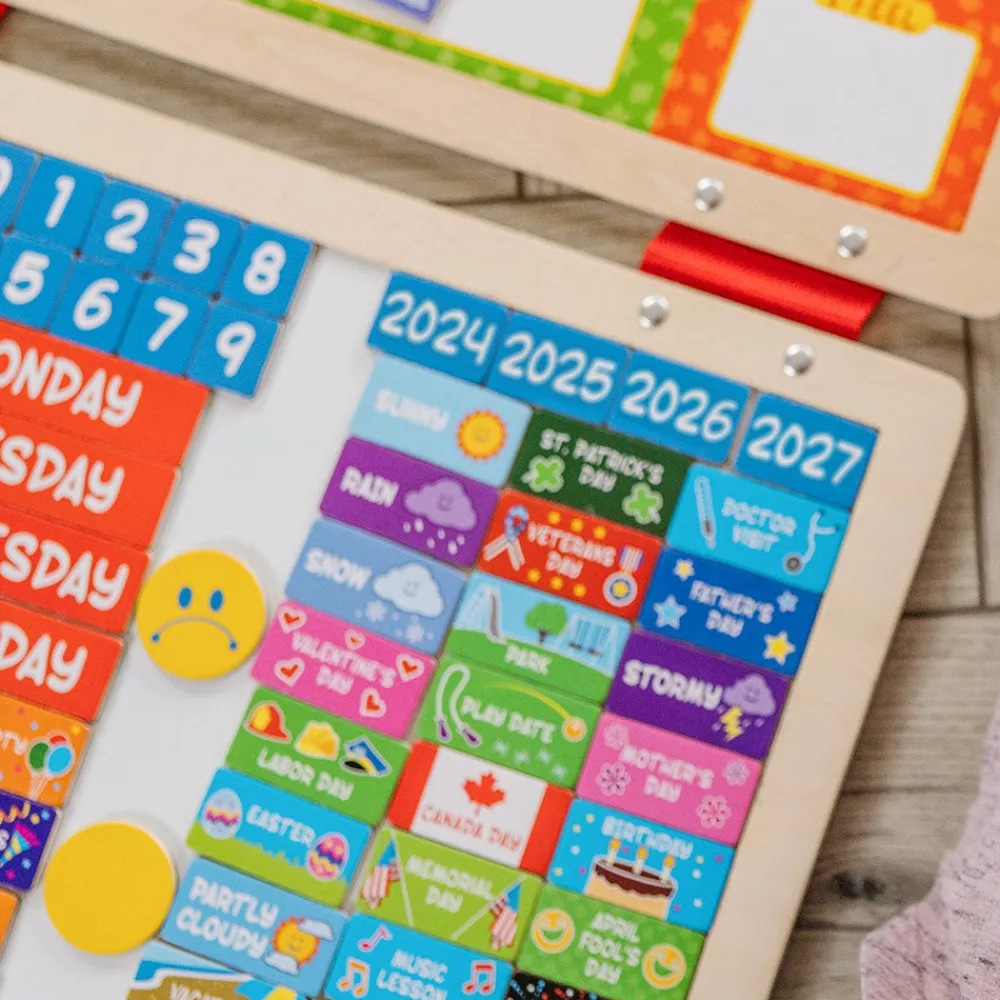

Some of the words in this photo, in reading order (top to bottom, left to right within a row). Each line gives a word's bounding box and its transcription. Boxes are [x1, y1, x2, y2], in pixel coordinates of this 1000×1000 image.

[45, 174, 76, 229] 1
[105, 198, 149, 254] 2
[173, 217, 220, 274] 3
[243, 240, 287, 295] 8
[3, 249, 51, 305] 5
[73, 277, 120, 332] 6
[147, 297, 190, 352] 7
[215, 321, 258, 379] 9
[379, 289, 498, 367] 2024
[498, 330, 618, 404] 2025
[621, 370, 739, 443] 2026
[747, 414, 865, 486] 2027
[341, 465, 400, 508] RAIN
[579, 464, 618, 493] DAY
[721, 496, 798, 537] DOCTOR
[527, 522, 618, 569] VETERANS
[545, 551, 584, 580] DAY
[304, 547, 373, 591] SNOW
[706, 608, 745, 638] DAY
[315, 665, 355, 695] DAY
[622, 658, 725, 711] STORMY
[256, 747, 316, 787] LABOR
[316, 770, 355, 801] DAY
[643, 774, 684, 803] DAY
[245, 803, 317, 845] EASTER
[420, 803, 484, 841] CANADA
[488, 824, 525, 853] DAY
[600, 814, 695, 861] BIRTHDAY
[405, 855, 496, 901] MEMORIAL
[425, 885, 464, 914] DAY
[188, 875, 279, 930] PARTLY
[175, 907, 270, 960] CLOUDY
[390, 949, 449, 985] MUSIC
[584, 957, 623, 986] DAY
